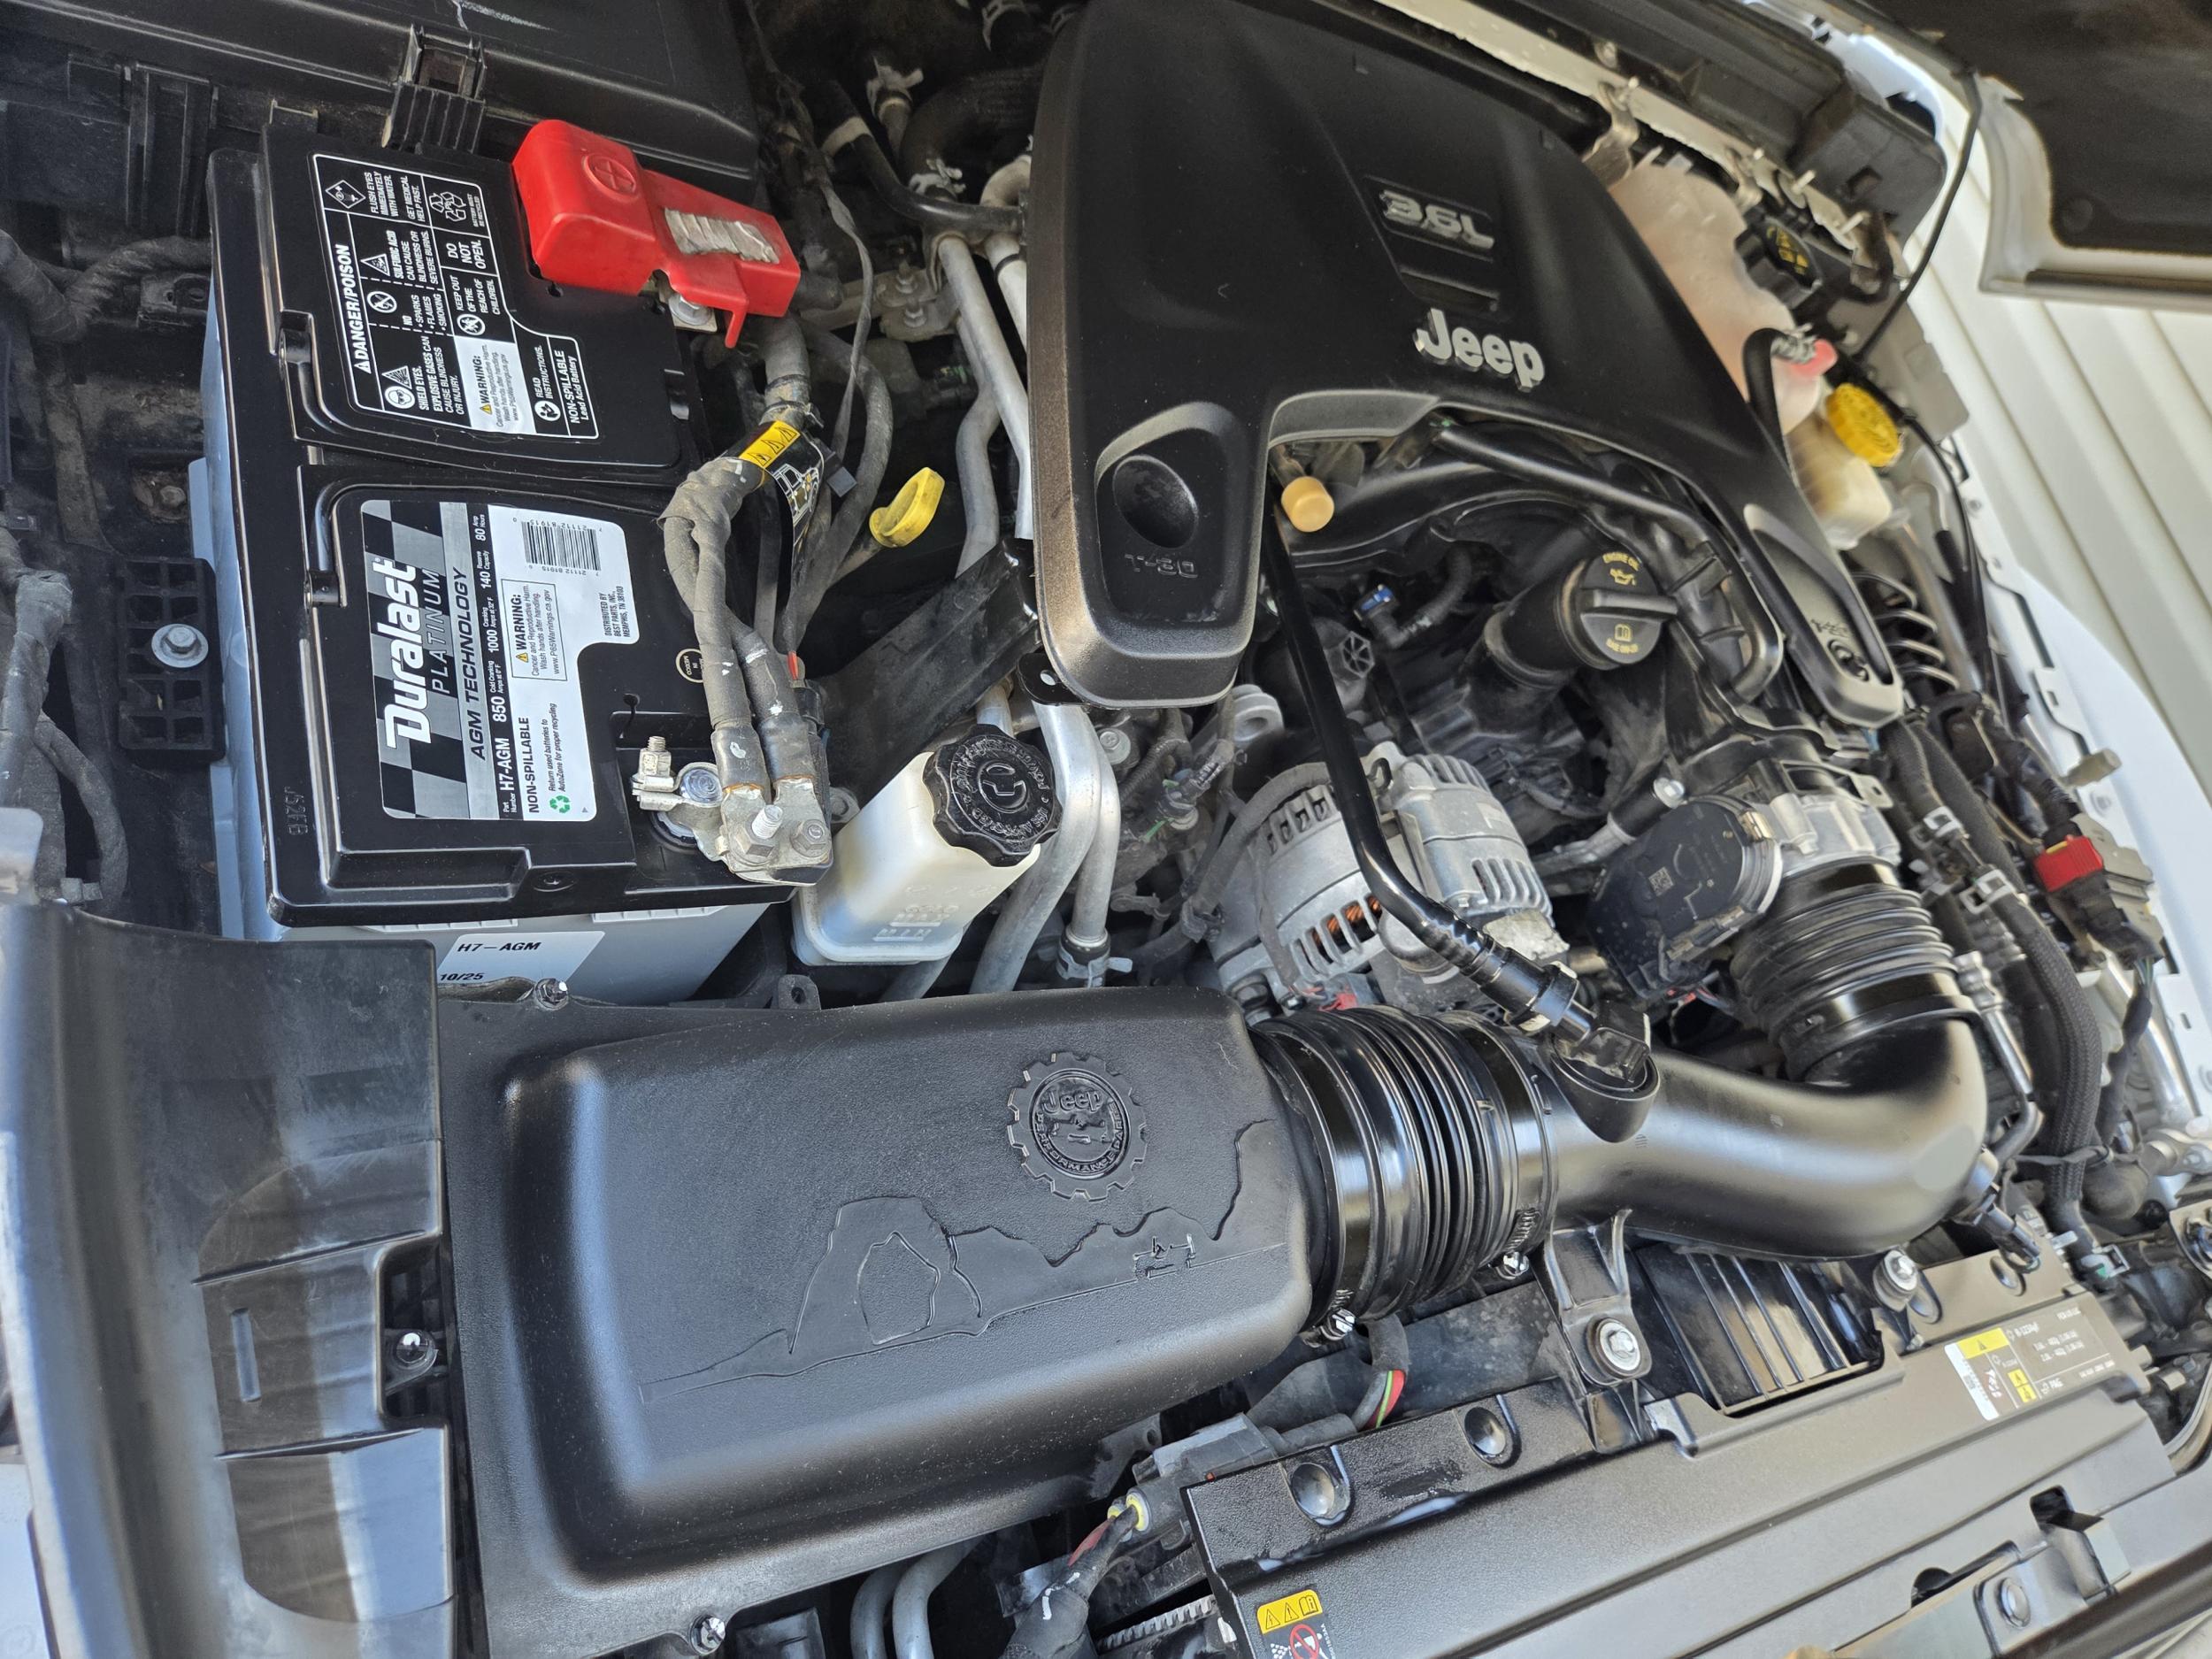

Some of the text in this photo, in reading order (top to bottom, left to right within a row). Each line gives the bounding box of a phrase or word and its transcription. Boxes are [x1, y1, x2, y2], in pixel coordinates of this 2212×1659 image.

[365, 172, 379, 213] FLUSH EYES
[373, 171, 389, 215] IMMEDIATELY
[400, 176, 415, 219] GET MEDICAL
[388, 200, 399, 217] WITH
[416, 204, 426, 222] HELP
[386, 230, 404, 279] SULFURIC ACID
[401, 241, 416, 280] CAN CAUSE
[411, 231, 426, 282] BLINDNESS OR
[446, 242, 458, 258] DO
[458, 242, 472, 264] NOT
[471, 240, 487, 269] OPEN.
[426, 256, 439, 284] SEVERE
[335, 243, 369, 359] DANGER/POISON
[449, 274, 464, 311] KEEP OUT
[465, 287, 476, 312] OF THE
[474, 278, 488, 313] REACH OF
[402, 316, 413, 326] NO
[1413, 307, 1545, 393] Jeep
[420, 336, 443, 412] EXPLOSIVE GASES CAN
[434, 346, 454, 413] CAUSE BLINDNESS
[472, 355, 490, 403] WARNING:
[485, 361, 496, 396] Reproductive
[534, 345, 553, 399] INSTRUCTIONS.
[416, 385, 430, 411] SHIELD
[533, 377, 544, 398] READ
[555, 349, 580, 424] NON-SPILLABLE
[567, 356, 589, 420] Lead Acid Battery
[455, 403, 465, 415] OR
[491, 396, 500, 407] and
[495, 408, 503, 427] Cancer
[474, 528, 486, 541] 80
[1602, 552, 1640, 572] ENGINE OIL
[480, 571, 492, 589] 140
[616, 586, 626, 603] 38103
[511, 594, 527, 650] WARNING:
[525, 603, 535, 641] Reproductive
[600, 601, 612, 636] DISTRIBUTED
[610, 604, 619, 623] PARTS,
[620, 611, 631, 637] MEMPHIS,
[422, 569, 450, 694] PLATINUM
[487, 630, 499, 653] 1000
[537, 633, 546, 651] hands
[543, 589, 560, 674] www.P65Warnings.ca.gov
[611, 623, 621, 637] BEST
[373, 559, 432, 749] Duralast
[528, 642, 537, 654] and
[452, 566, 486, 761] AGM TECHNOLOGY
[531, 655, 540, 676] Cancer
[683, 656, 692, 676] MEXICO
[490, 695, 507, 723] 850
[542, 727, 552, 753] batteries
[549, 703, 565, 792] AutoZone for proper recycling
[495, 737, 515, 791] H7-AGM
[518, 717, 540, 813] NON-SPILLABLE
[544, 754, 553, 770] used
[546, 771, 556, 792] Return
[440, 972, 485, 981] 10/25
[1042, 1089, 1104, 1114] Jeep
[1035, 1113, 1117, 1173] PERFORMANCE
